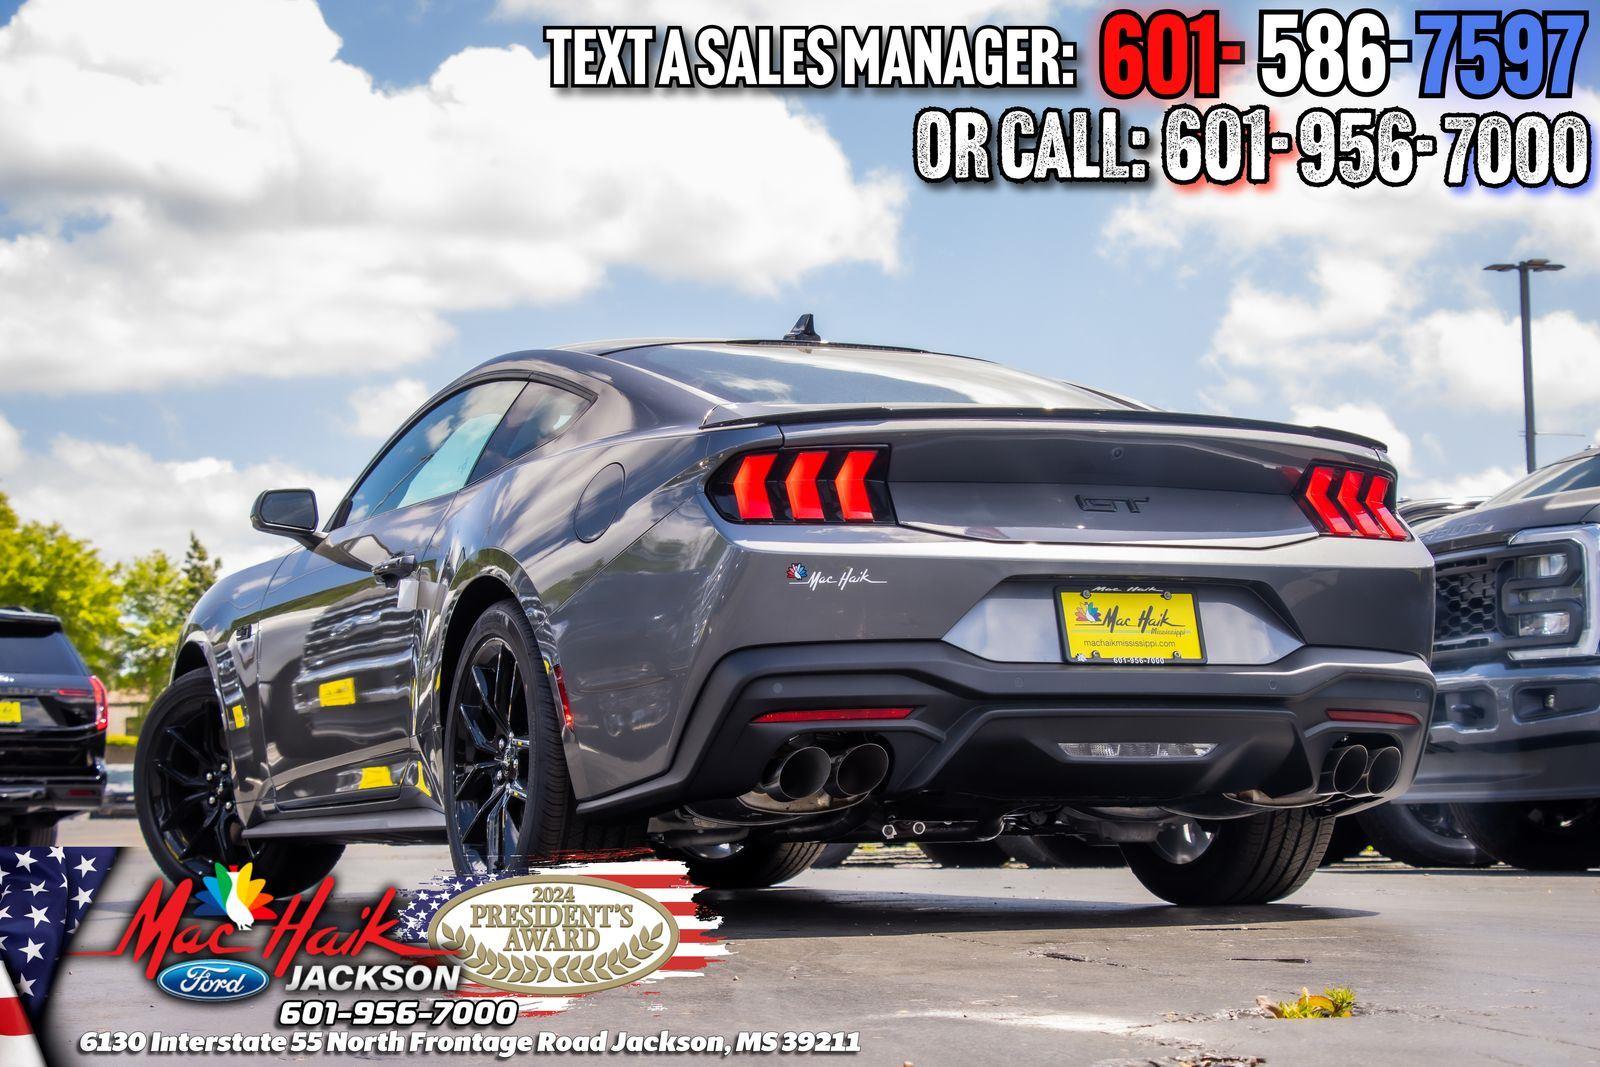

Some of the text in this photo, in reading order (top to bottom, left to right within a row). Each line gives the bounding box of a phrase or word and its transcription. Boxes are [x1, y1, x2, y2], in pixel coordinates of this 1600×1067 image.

[1074, 494, 1150, 513] GT
[804, 567, 884, 591] Mac Haik
[1097, 605, 1181, 634] Mac Haik
[1083, 639, 1176, 649] machaikmississippi.com
